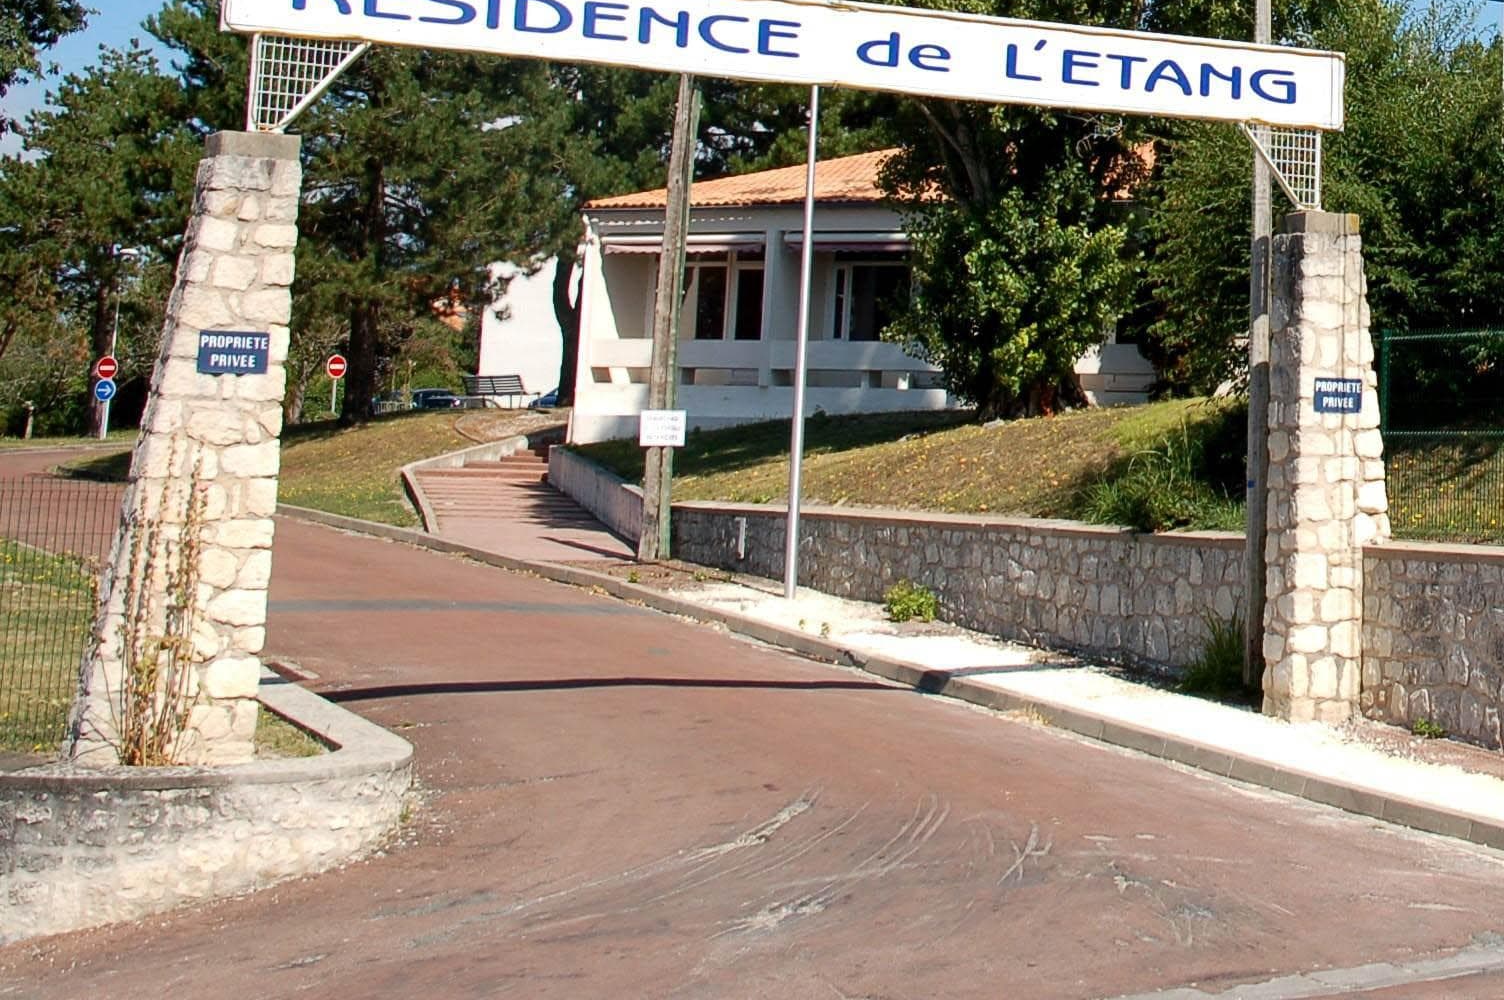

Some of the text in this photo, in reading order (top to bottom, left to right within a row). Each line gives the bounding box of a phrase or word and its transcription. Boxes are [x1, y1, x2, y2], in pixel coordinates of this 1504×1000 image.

[856, 32, 950, 72] de
[1006, 39, 1298, 105] L'ETANG
[201, 335, 268, 350] PROPRIETE
[210, 353, 256, 368] PRIVEE
[1315, 381, 1361, 393] PROPRIETE
[1322, 396, 1354, 408] PRIVEE
